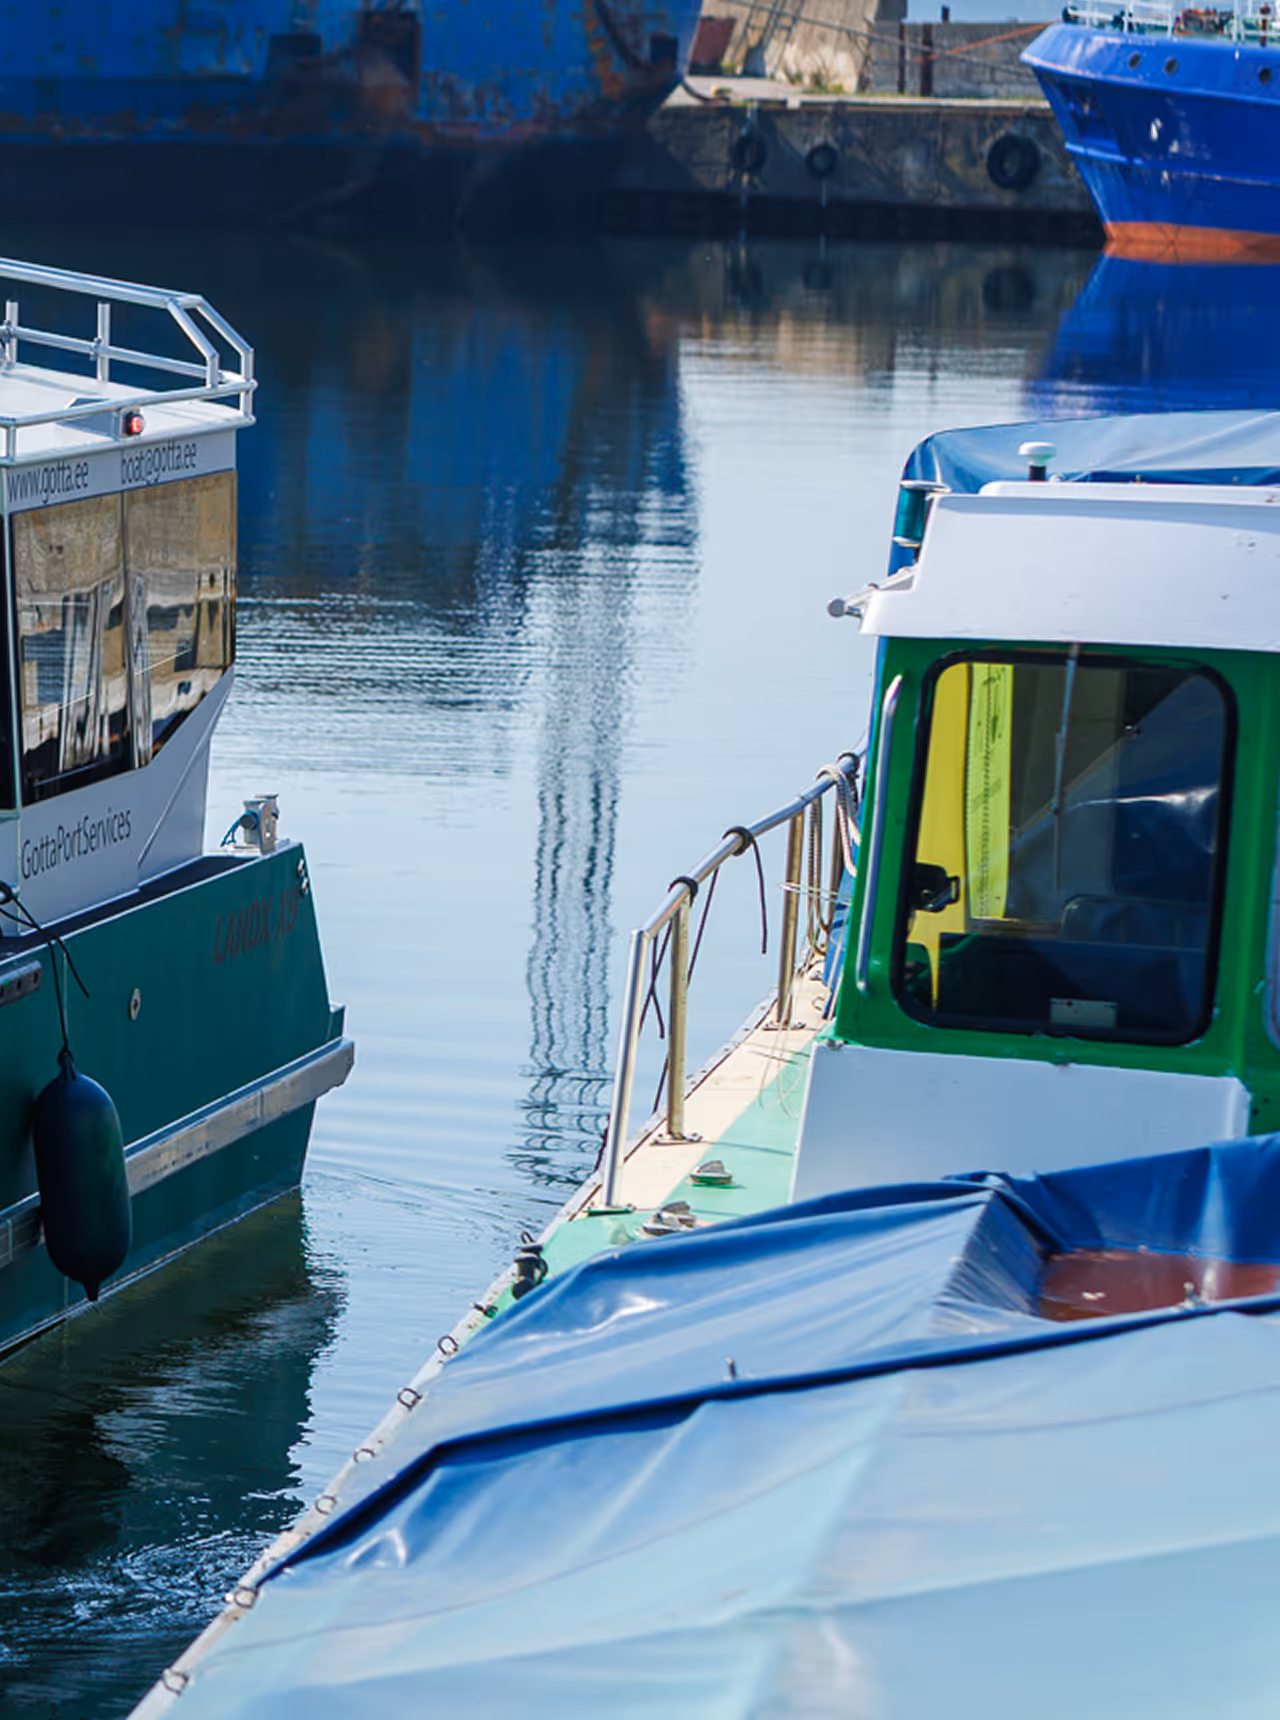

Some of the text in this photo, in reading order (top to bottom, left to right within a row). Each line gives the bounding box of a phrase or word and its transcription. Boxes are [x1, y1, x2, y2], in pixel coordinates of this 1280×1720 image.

[8, 460, 89, 504] www.gotta.ee
[121, 439, 197, 486] boat@gotta.ee
[21, 806, 131, 880] GottaPortServices
[213, 896, 273, 966] LANDX
